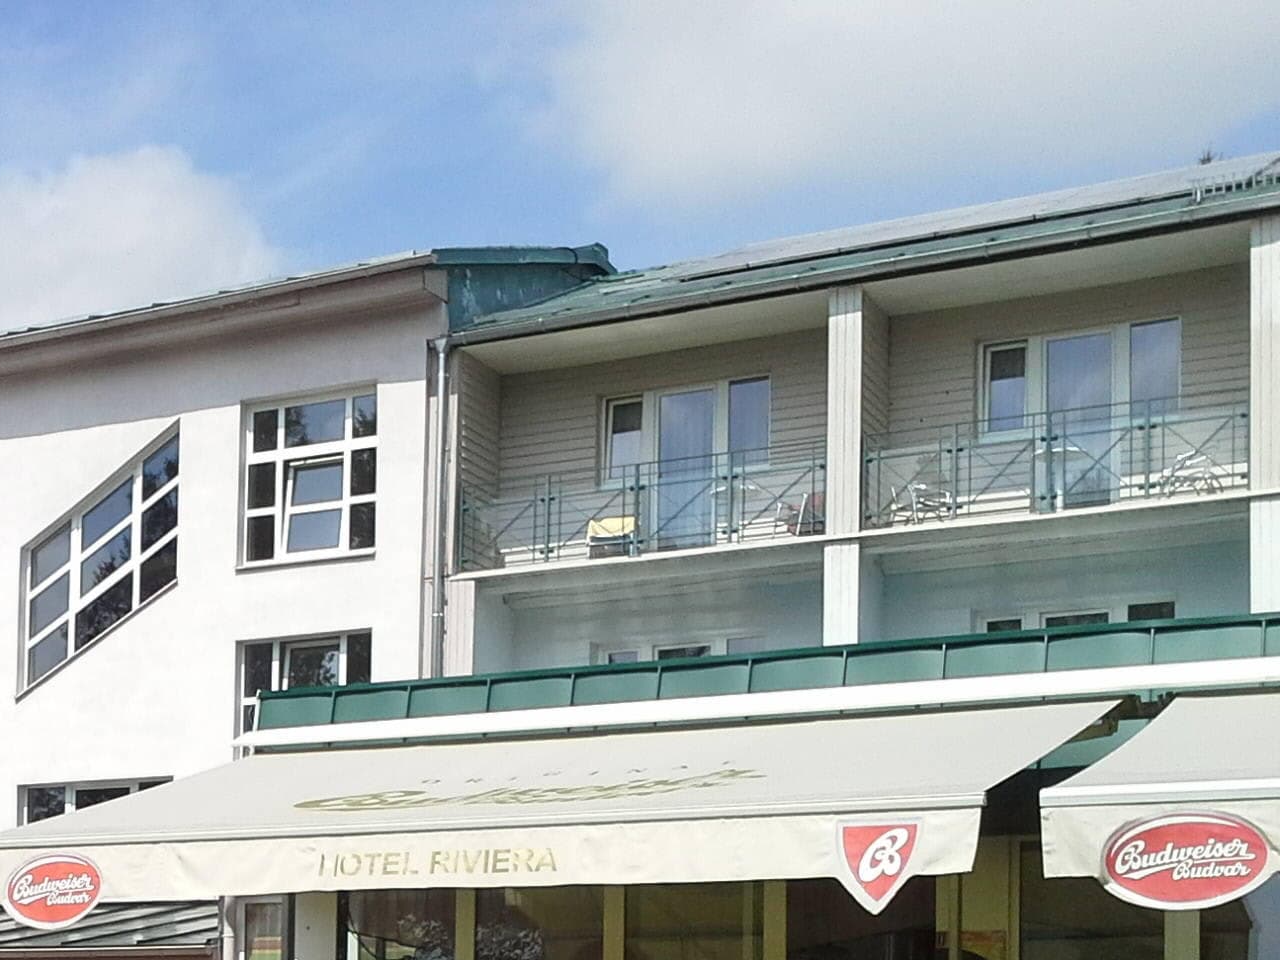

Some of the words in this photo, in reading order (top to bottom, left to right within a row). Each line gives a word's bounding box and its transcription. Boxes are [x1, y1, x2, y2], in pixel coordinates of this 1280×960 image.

[318, 852, 419, 877] HOTEL
[428, 848, 558, 875] RIVIERA
[1114, 838, 1256, 878] Budweiser
[1172, 860, 1252, 881] Budvar
[12, 873, 95, 903] Budweiser
[46, 890, 91, 906] Budvar
